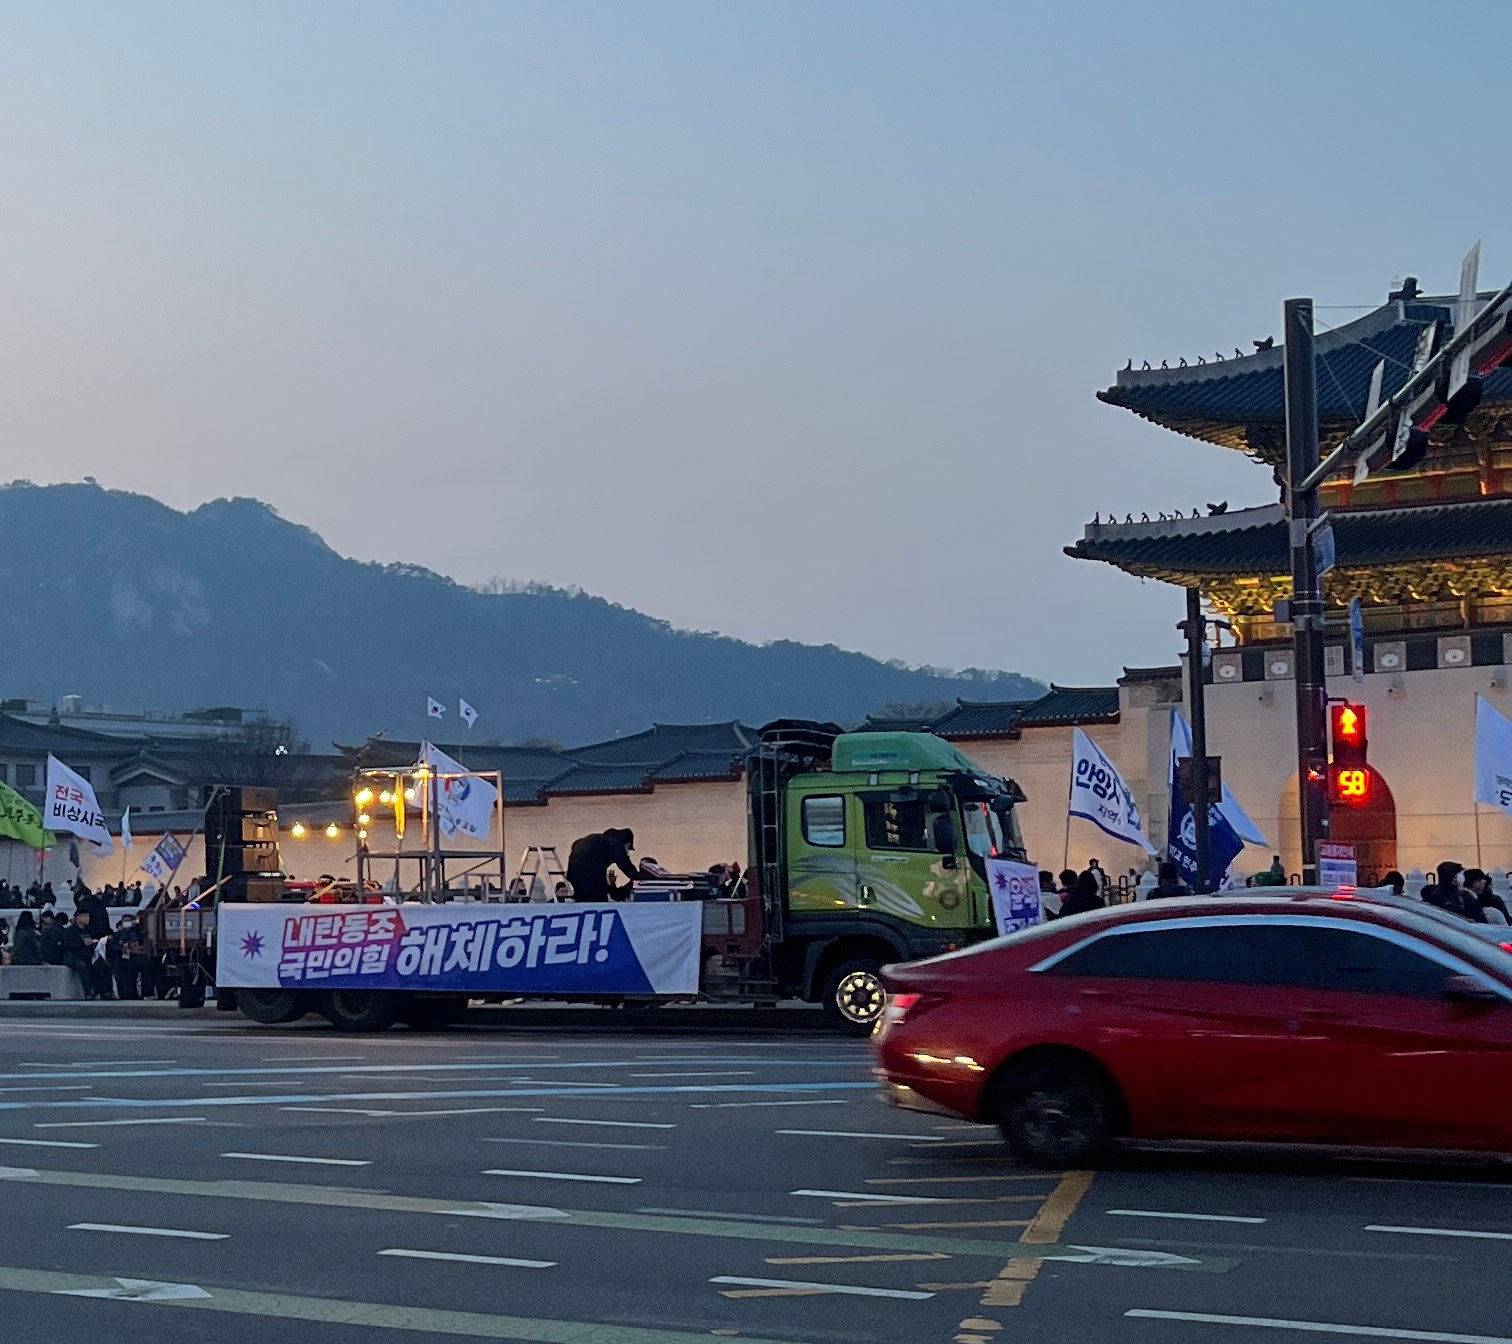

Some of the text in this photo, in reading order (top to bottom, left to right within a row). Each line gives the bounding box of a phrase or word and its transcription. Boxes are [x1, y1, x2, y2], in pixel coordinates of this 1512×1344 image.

[55, 784, 84, 805] 전국
[1339, 770, 1366, 796] 58
[283, 910, 397, 948] 내란동조
[396, 912, 616, 976] 해체하라!
[279, 944, 391, 981] 국민의힘
